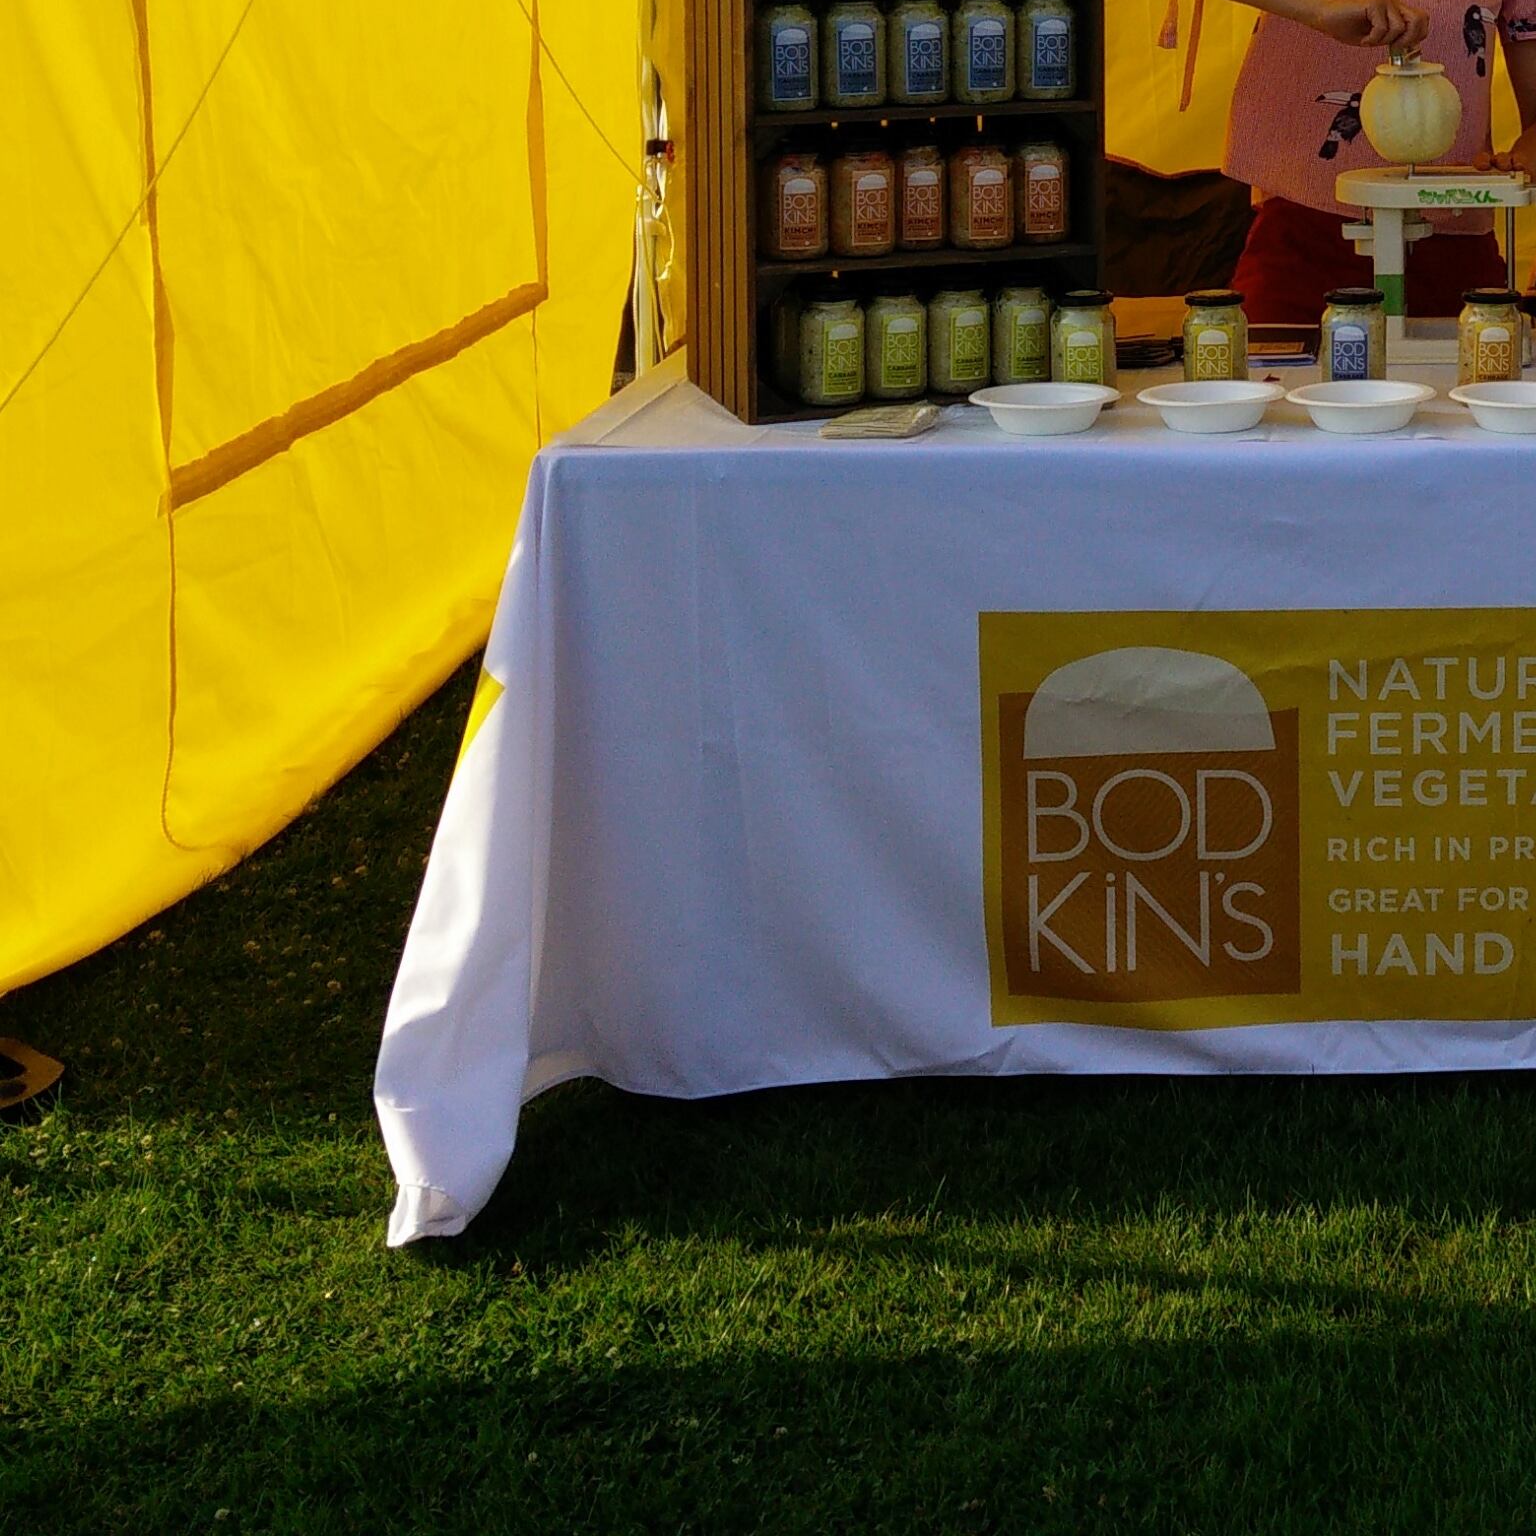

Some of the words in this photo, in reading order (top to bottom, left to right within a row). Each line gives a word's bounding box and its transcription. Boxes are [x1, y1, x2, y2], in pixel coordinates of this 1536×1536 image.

[1197, 345, 1229, 360] BOD
[1334, 342, 1365, 356] BOD
[1478, 343, 1510, 357] BOD
[1027, 768, 1275, 865] BOD
[1326, 835, 1415, 862] RICH
[1434, 835, 1471, 861] IN
[1327, 887, 1446, 915] GREAT
[1457, 885, 1529, 913] FOR
[1330, 932, 1515, 977] HAND
